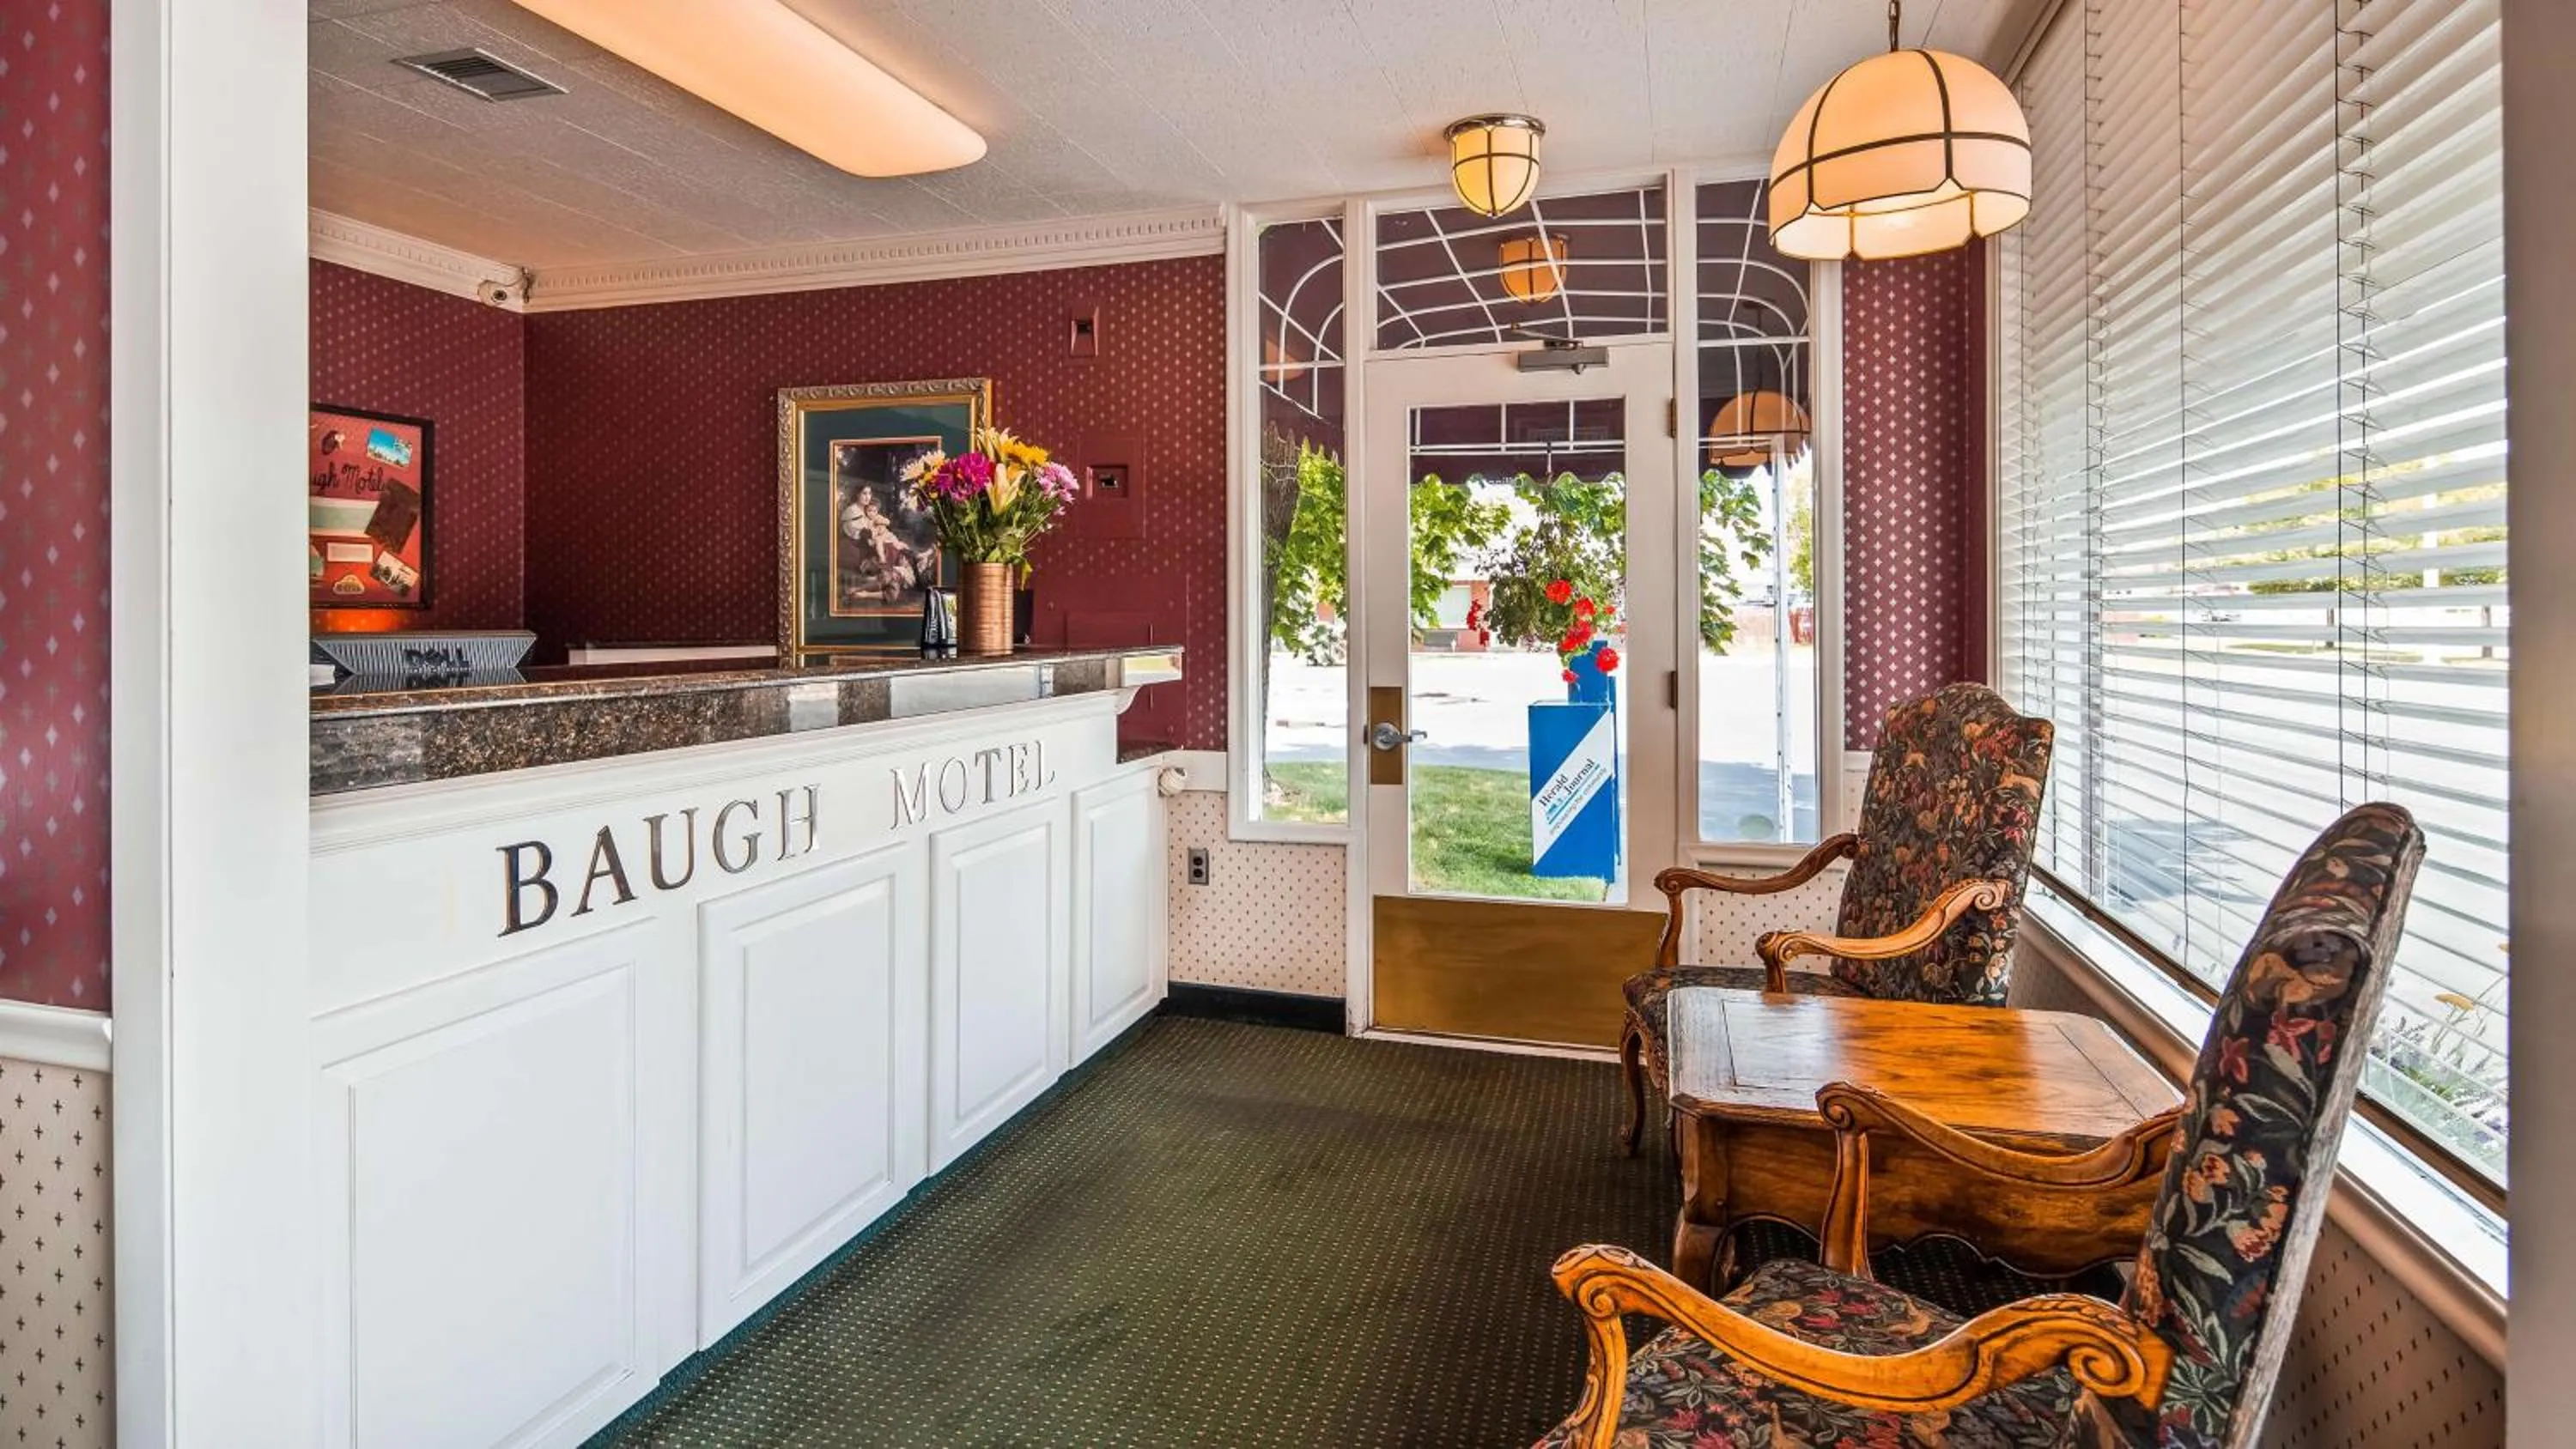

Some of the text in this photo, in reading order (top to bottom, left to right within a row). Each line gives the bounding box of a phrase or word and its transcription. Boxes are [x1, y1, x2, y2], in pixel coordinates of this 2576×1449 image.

[310, 461, 339, 494] ugh
[1538, 774, 1569, 807] Herald
[1564, 759, 1595, 795] Journal
[495, 739, 1056, 938] BAUGH MOTEL
